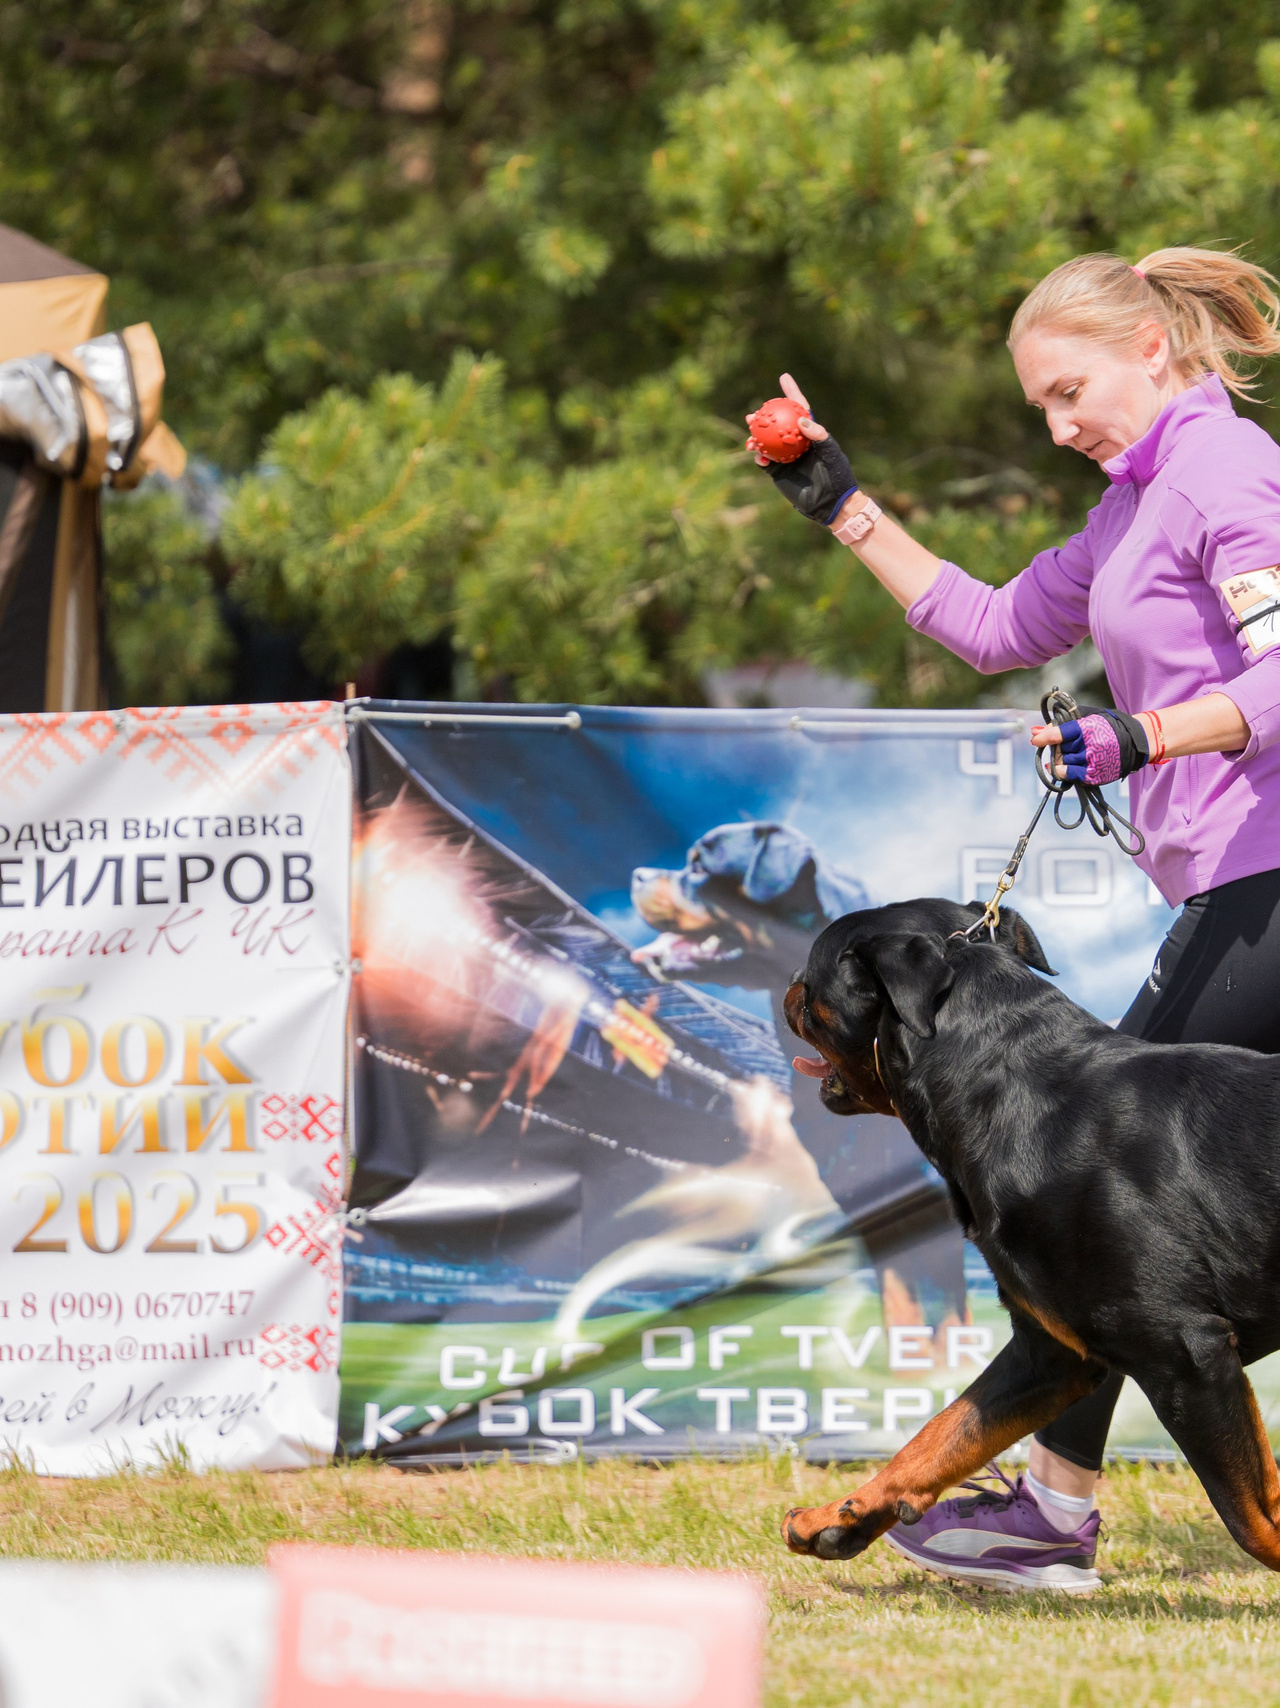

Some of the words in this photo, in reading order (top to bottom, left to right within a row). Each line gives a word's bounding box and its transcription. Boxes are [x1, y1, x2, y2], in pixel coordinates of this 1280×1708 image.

[123, 814, 303, 839] выставка
[0, 842, 314, 908] ЕЙЛЕРОВ
[0, 982, 256, 1088] бок
[12, 1171, 264, 1255] 2025
[21, 1291, 37, 1319] 8
[50, 1291, 123, 1327] (909)
[136, 1290, 255, 1319] 0670747
[642, 1325, 753, 1371] OF
[781, 1325, 994, 1370] TVER
[0, 1391, 56, 1423] ей
[697, 1388, 958, 1437] ТВЕР
